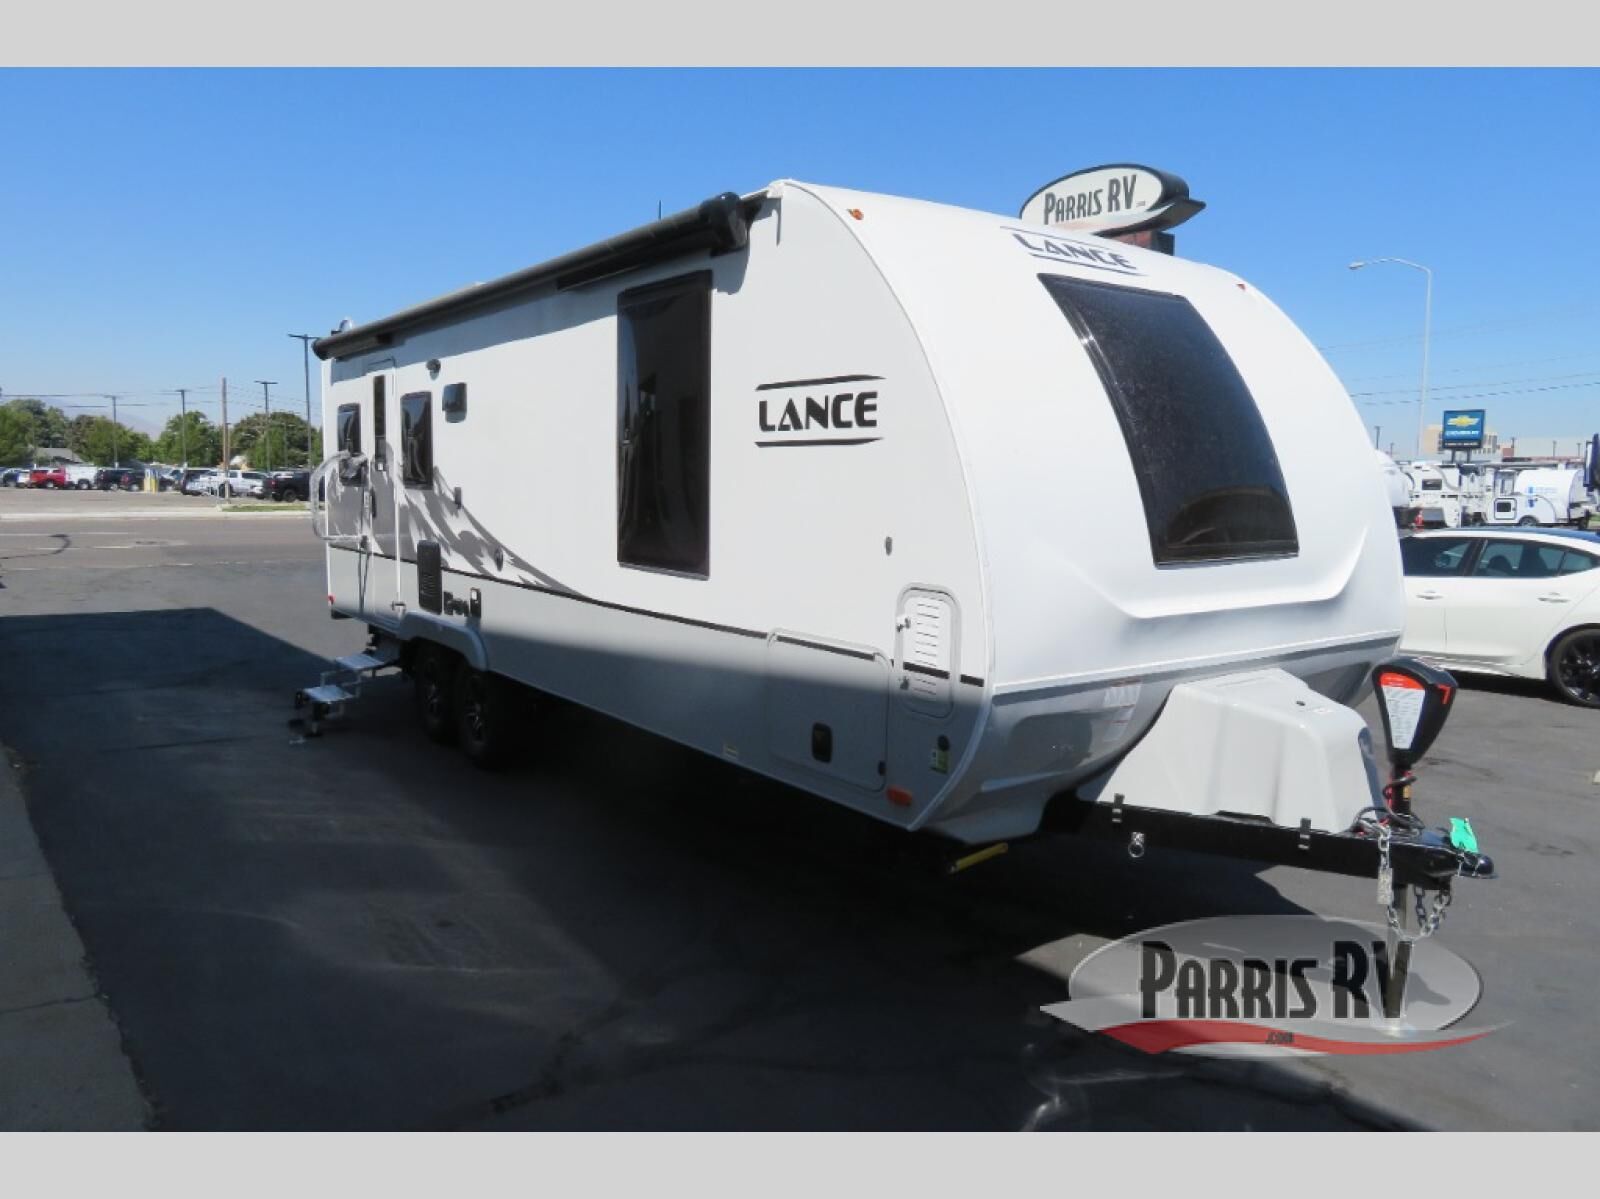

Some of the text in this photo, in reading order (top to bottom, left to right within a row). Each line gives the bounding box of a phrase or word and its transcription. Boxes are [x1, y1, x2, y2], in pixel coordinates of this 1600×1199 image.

[1043, 174, 1138, 226] PARRIS RV
[1012, 233, 1138, 271] LANCE
[758, 390, 879, 432] LANCE
